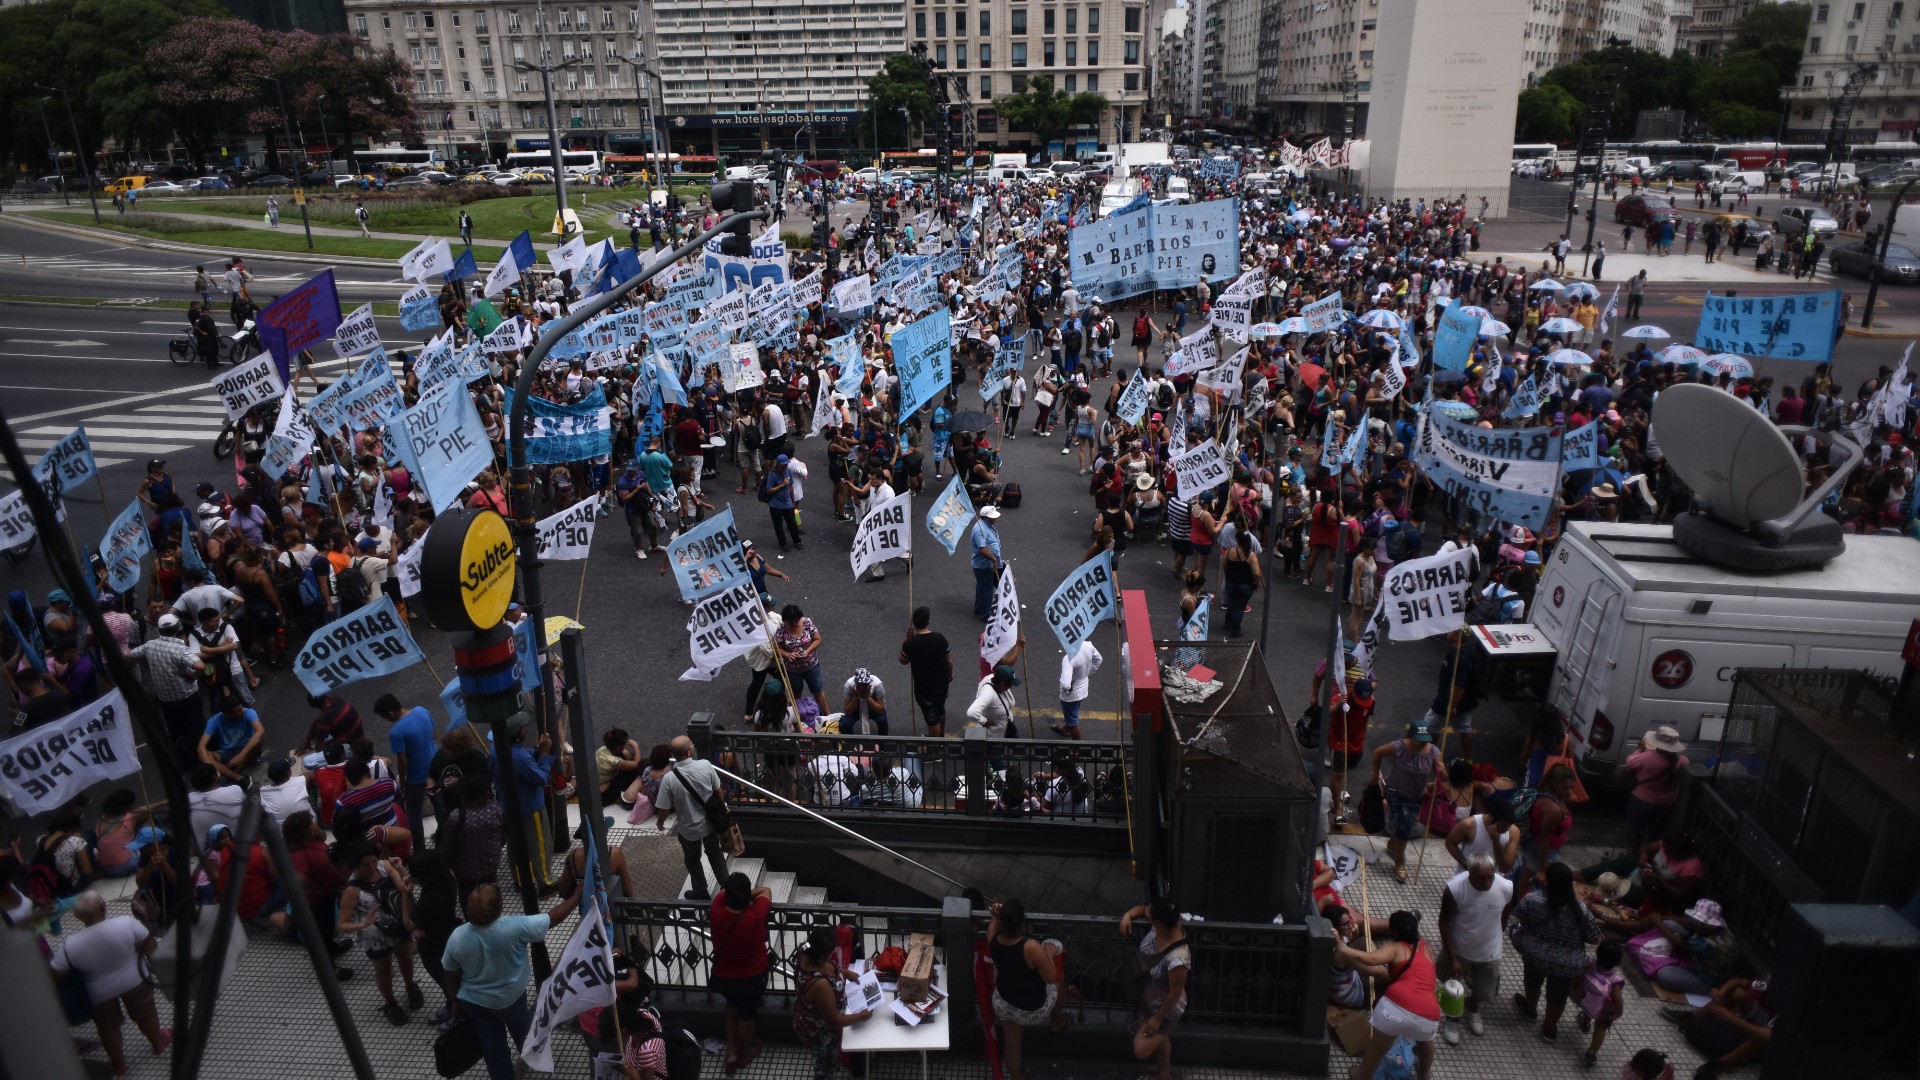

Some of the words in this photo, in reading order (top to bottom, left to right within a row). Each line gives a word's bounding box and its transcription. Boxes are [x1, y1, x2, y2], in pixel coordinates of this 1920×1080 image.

[712, 113, 848, 125] www.hotelesglobales.com
[1643, 112, 1676, 120] TICKETS
[1083, 213, 1227, 266] MOVIMIENTO
[1110, 235, 1191, 265] BARRIOS
[1121, 262, 1138, 277] DE
[1158, 256, 1183, 270] PIE
[930, 354, 942, 369] DE
[1706, 359, 1748, 373] BARRIOS
[933, 368, 944, 385] PIE
[571, 410, 599, 434] PIE
[439, 425, 473, 462] PIE
[464, 541, 511, 591] Subte
[1558, 548, 1570, 565] 80
[472, 586, 488, 605] Buenos
[488, 577, 499, 592] Aires
[507, 636, 515, 655] B
[1655, 659, 1688, 679] 26
